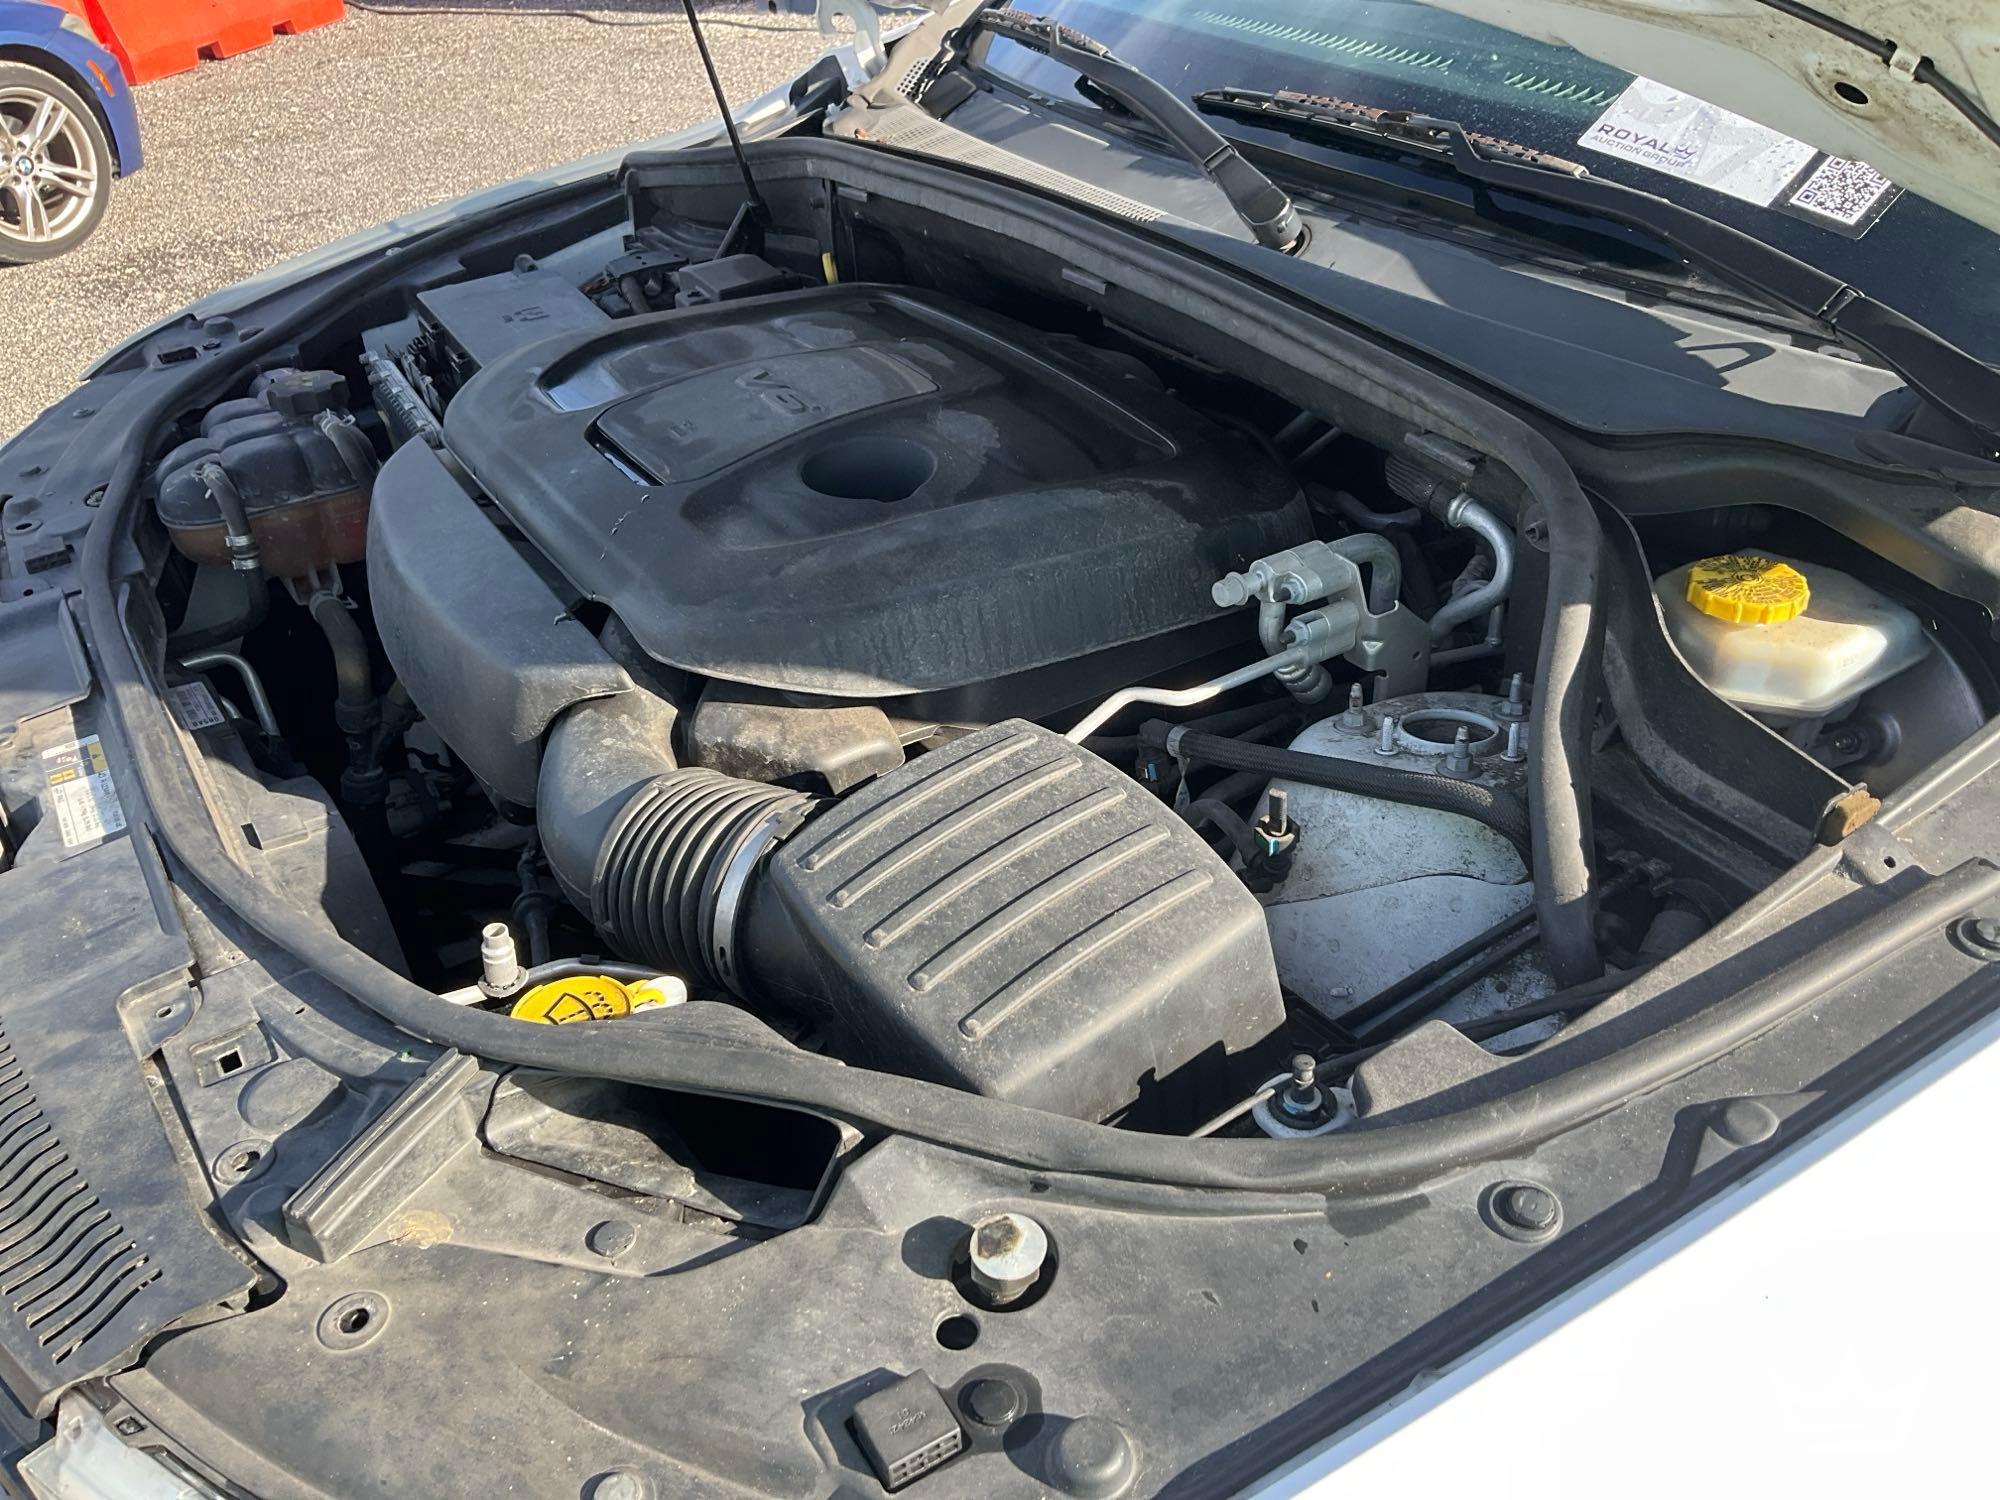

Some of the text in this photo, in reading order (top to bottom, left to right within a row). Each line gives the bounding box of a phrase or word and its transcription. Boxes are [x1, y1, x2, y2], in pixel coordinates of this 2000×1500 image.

[1591, 135, 1693, 168] AUCTION GROUP
[1597, 123, 1671, 154] ROYAL
